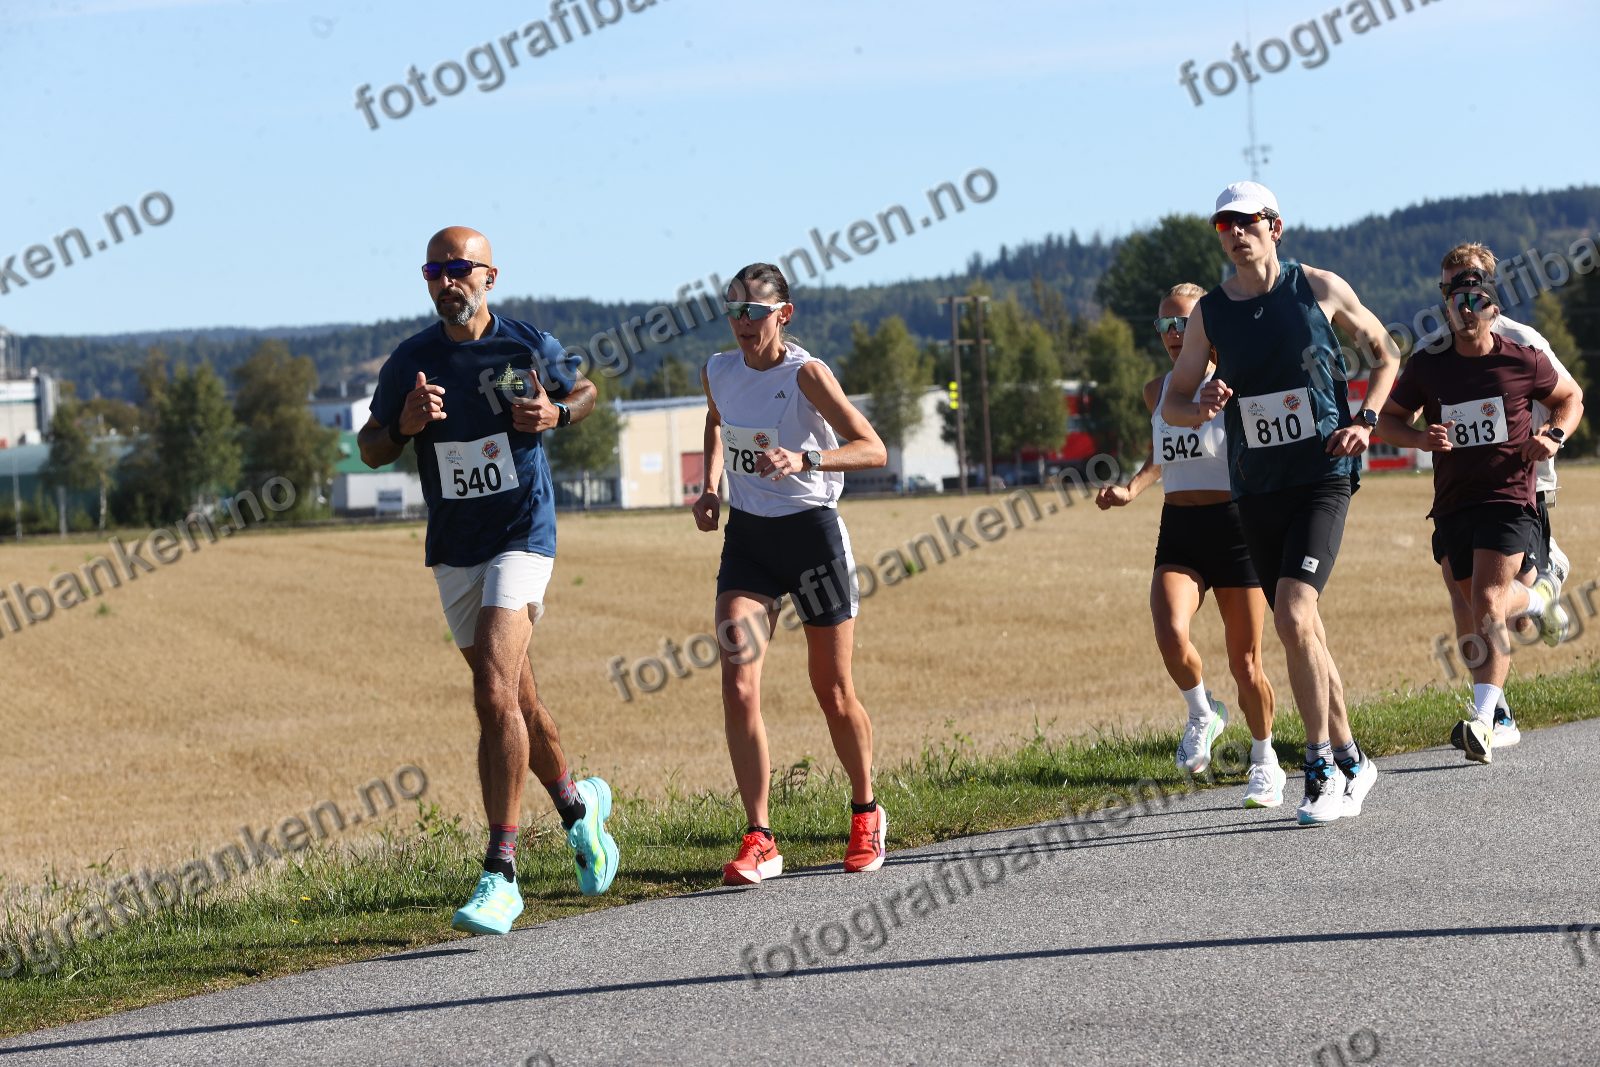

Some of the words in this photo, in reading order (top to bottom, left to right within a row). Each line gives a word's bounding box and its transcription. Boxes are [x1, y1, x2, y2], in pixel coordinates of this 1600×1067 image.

[1256, 413, 1302, 445] 810
[1455, 419, 1496, 446] 813
[1162, 433, 1203, 461] 542
[453, 462, 502, 497] 540
